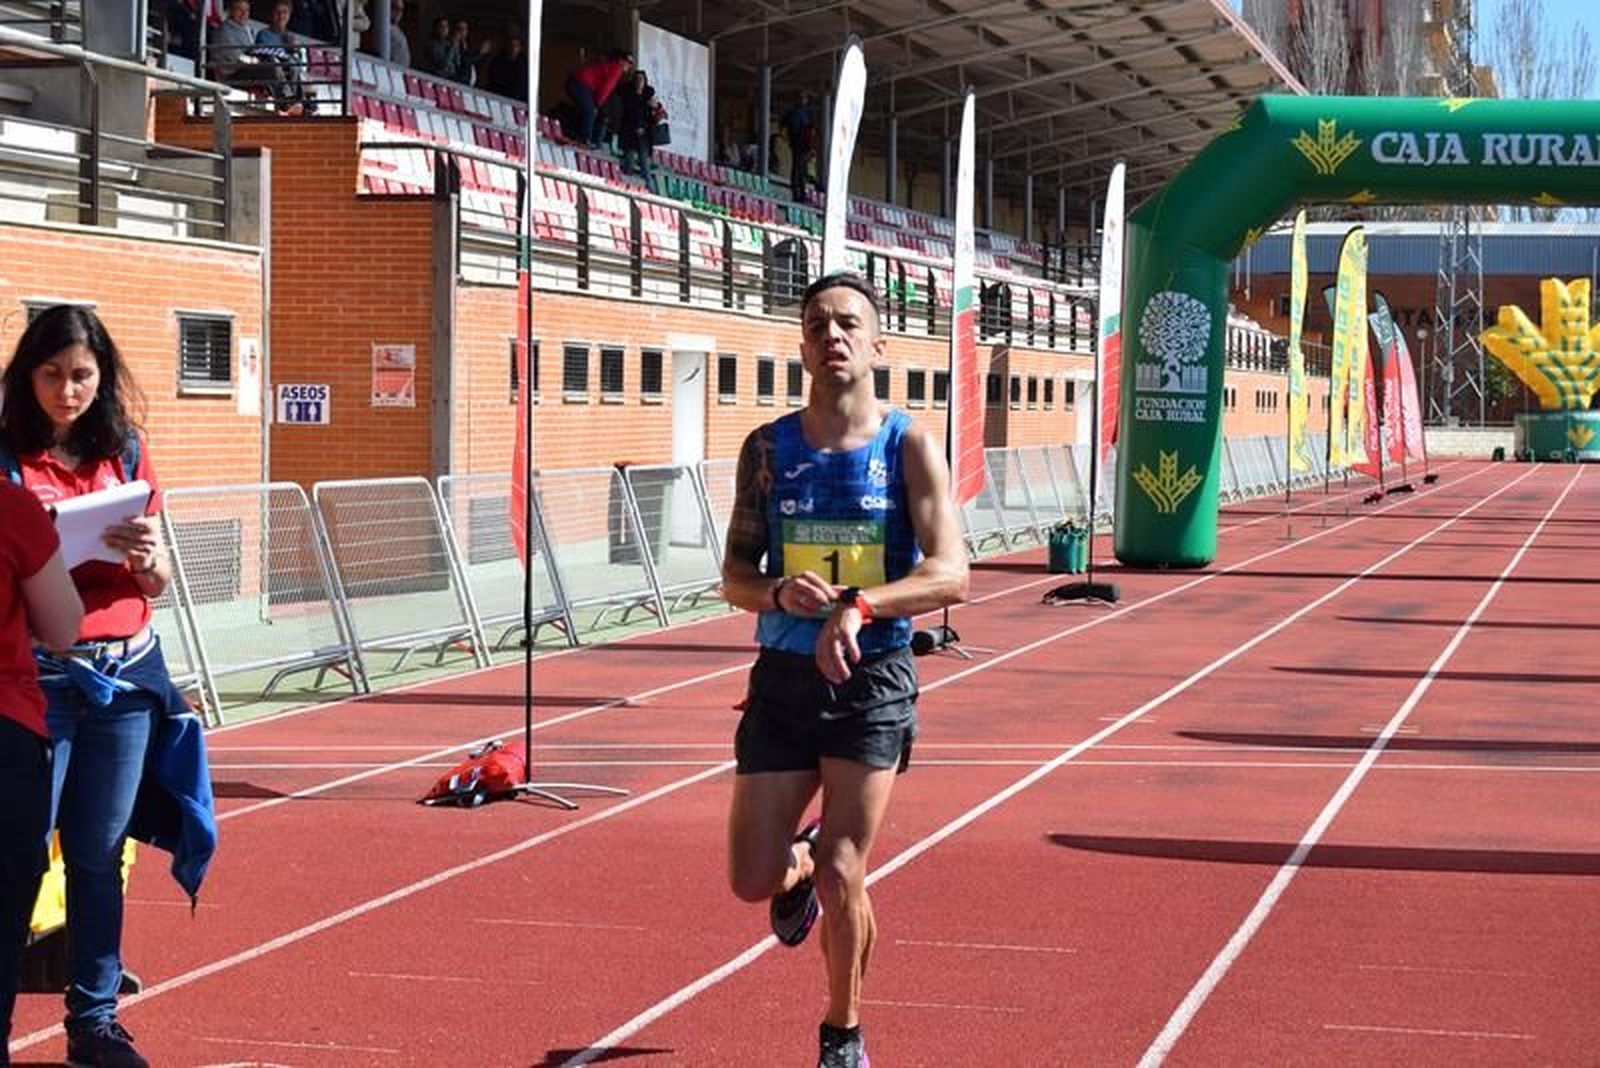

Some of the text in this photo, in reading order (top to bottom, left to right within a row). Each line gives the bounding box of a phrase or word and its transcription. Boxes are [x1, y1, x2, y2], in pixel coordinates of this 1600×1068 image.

[1371, 131, 1600, 166] CAJA RURA
[281, 386, 327, 400] ASEOS
[1135, 409, 1163, 420] CAJA
[822, 549, 839, 585] 1
